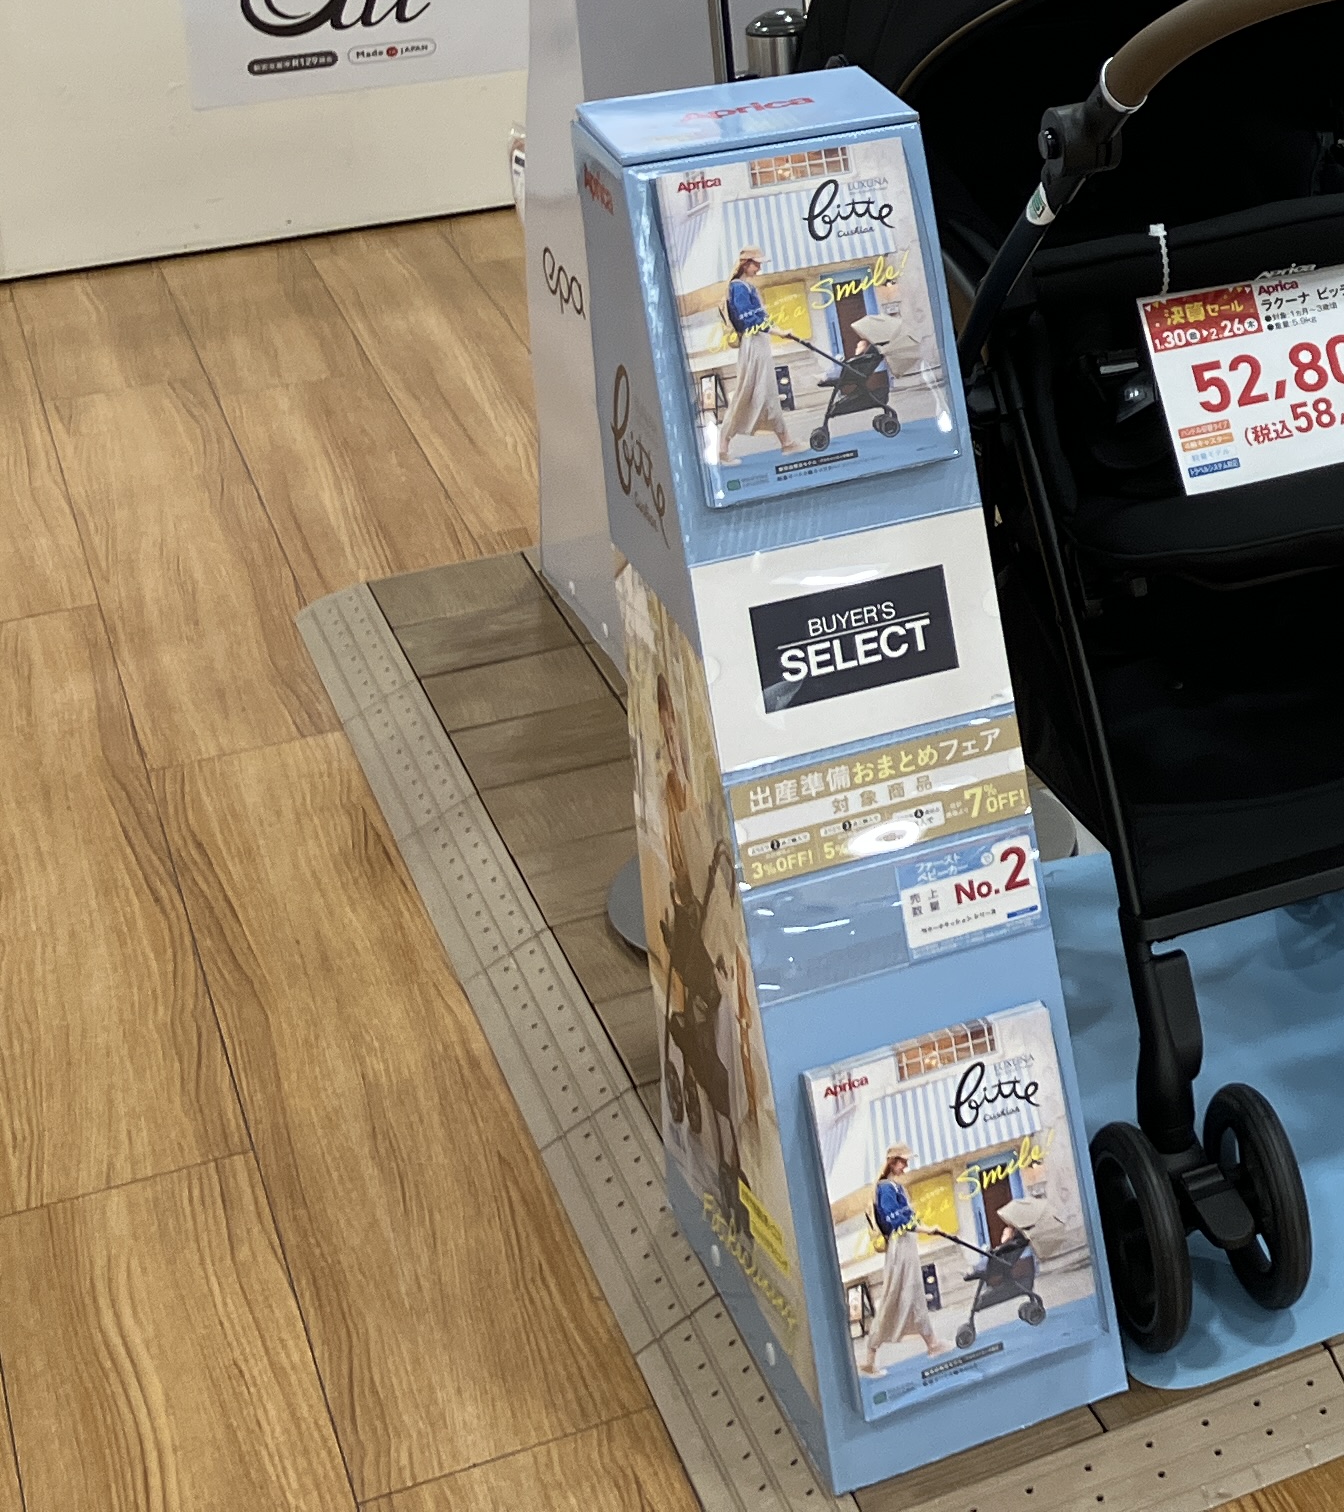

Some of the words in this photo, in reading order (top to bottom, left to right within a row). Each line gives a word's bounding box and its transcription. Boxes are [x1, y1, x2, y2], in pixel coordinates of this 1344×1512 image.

[678, 93, 816, 124] Aprica
[676, 175, 722, 194] Aprica
[809, 248, 911, 311] Smile!
[1257, 280, 1299, 296] Aprica
[1163, 299, 1245, 326] 決算セール
[1260, 292, 1309, 311] ラクーナ
[807, 600, 897, 638] BUYER'S
[780, 618, 931, 683] SELECT
[748, 726, 1002, 813] 出産準備おまとめフェア
[751, 849, 815, 880] 3%OFF!
[953, 846, 1032, 906] No.2
[822, 1074, 869, 1099] Aprica
[956, 1128, 1057, 1202] Smile!
